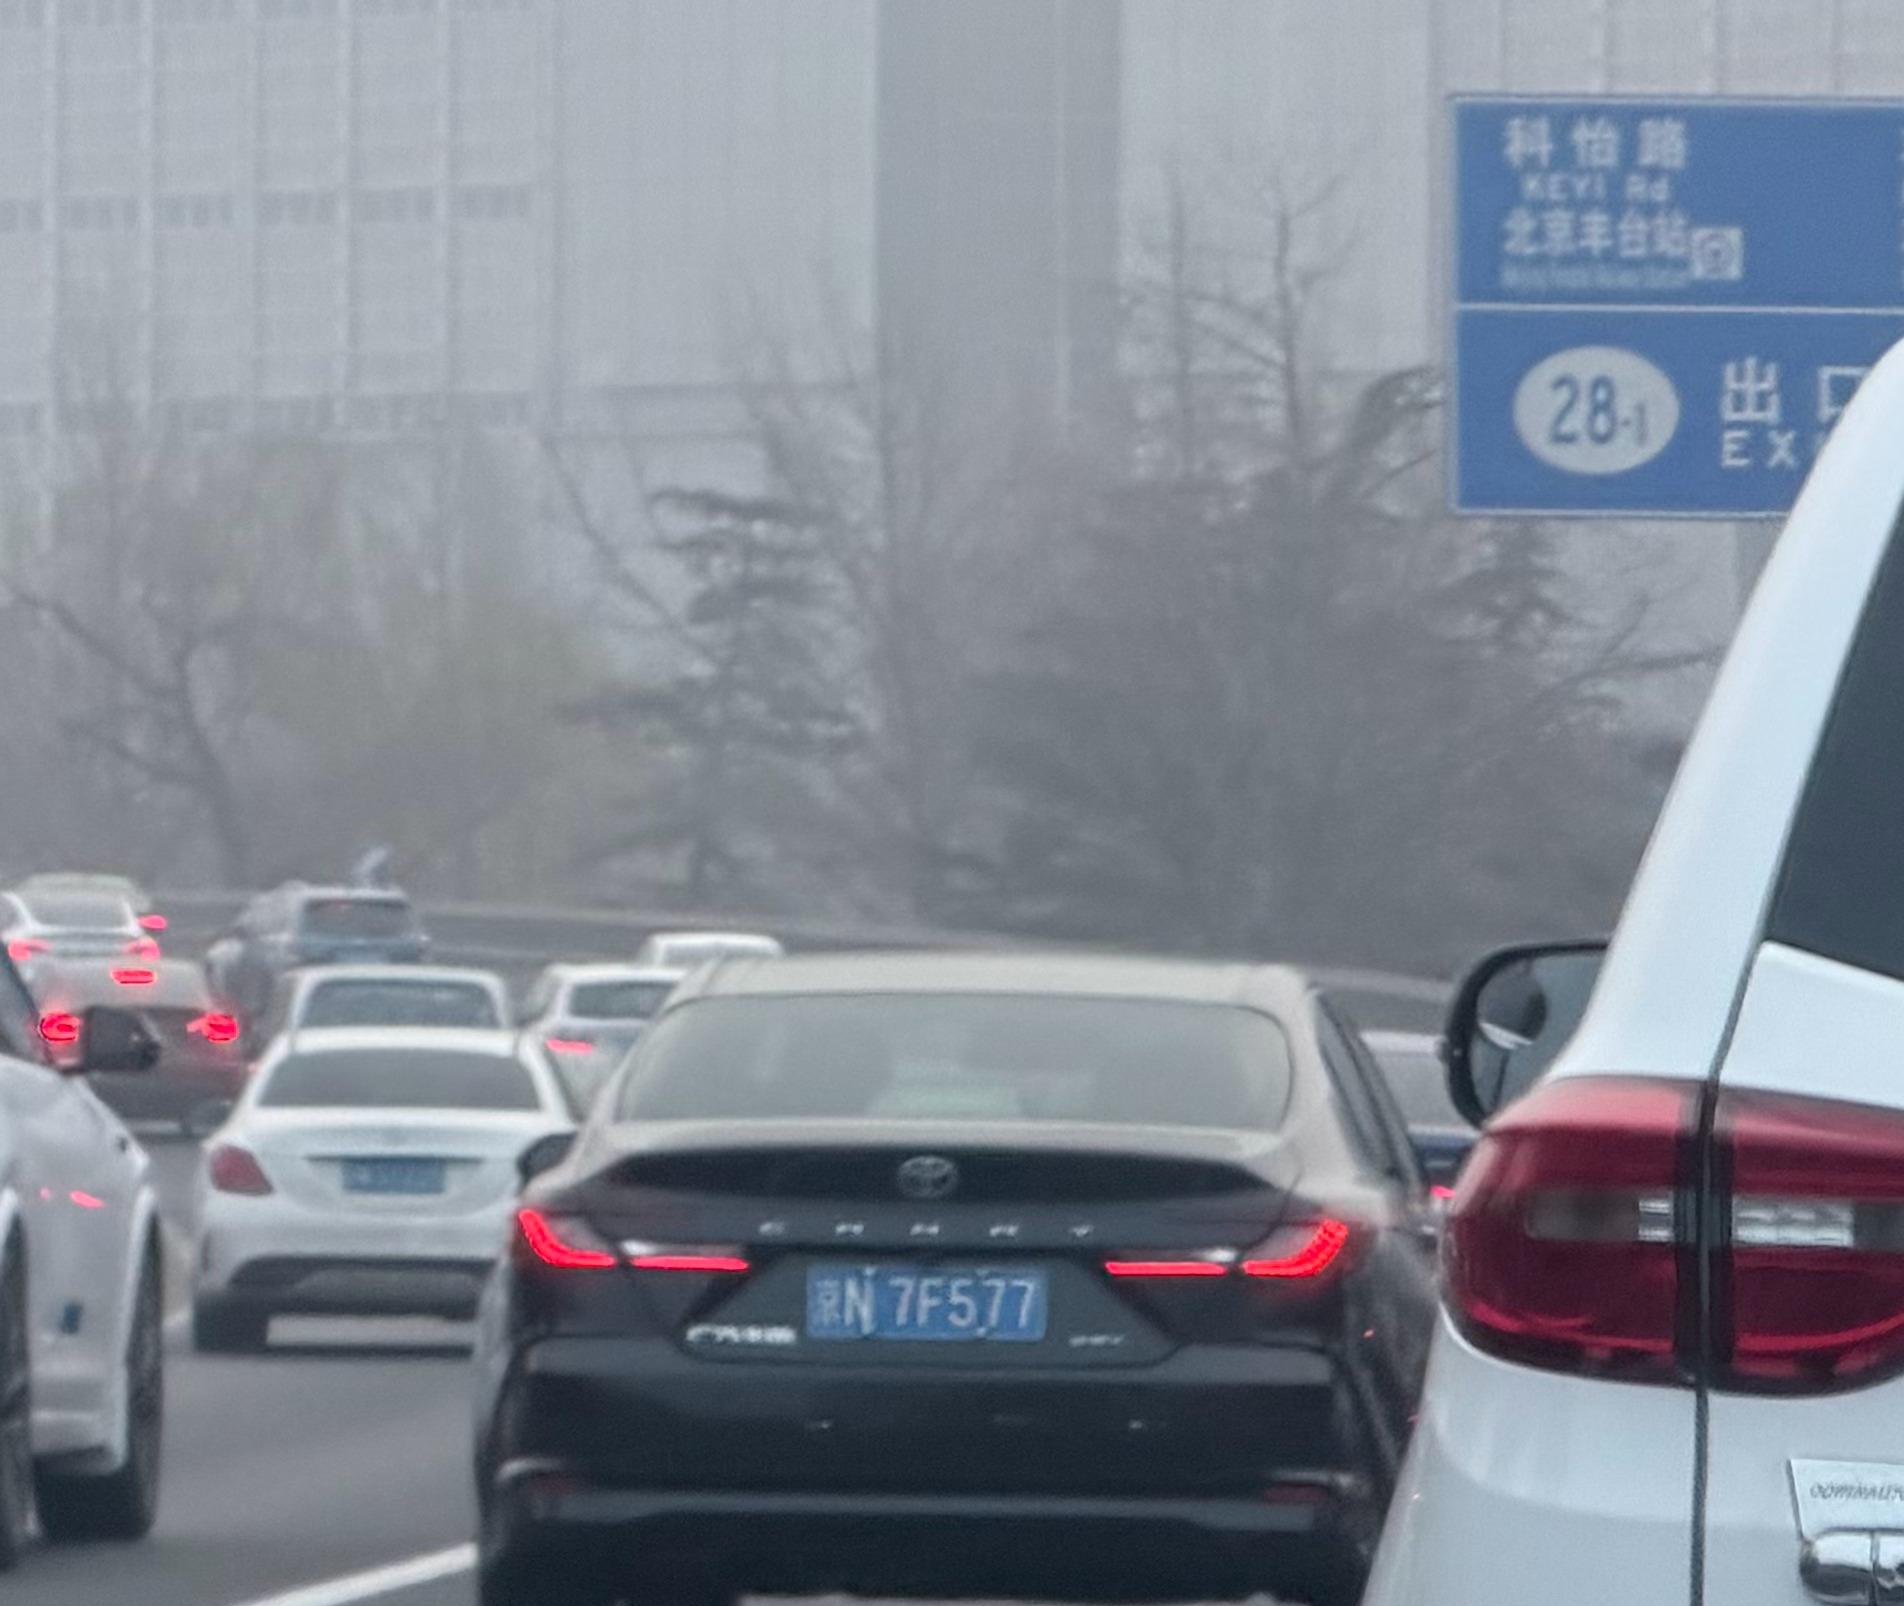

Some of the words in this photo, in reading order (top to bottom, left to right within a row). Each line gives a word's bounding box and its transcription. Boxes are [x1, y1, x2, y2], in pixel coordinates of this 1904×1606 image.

[1504, 116, 1687, 169] 科怡路
[1551, 373, 1648, 447] 28-1
